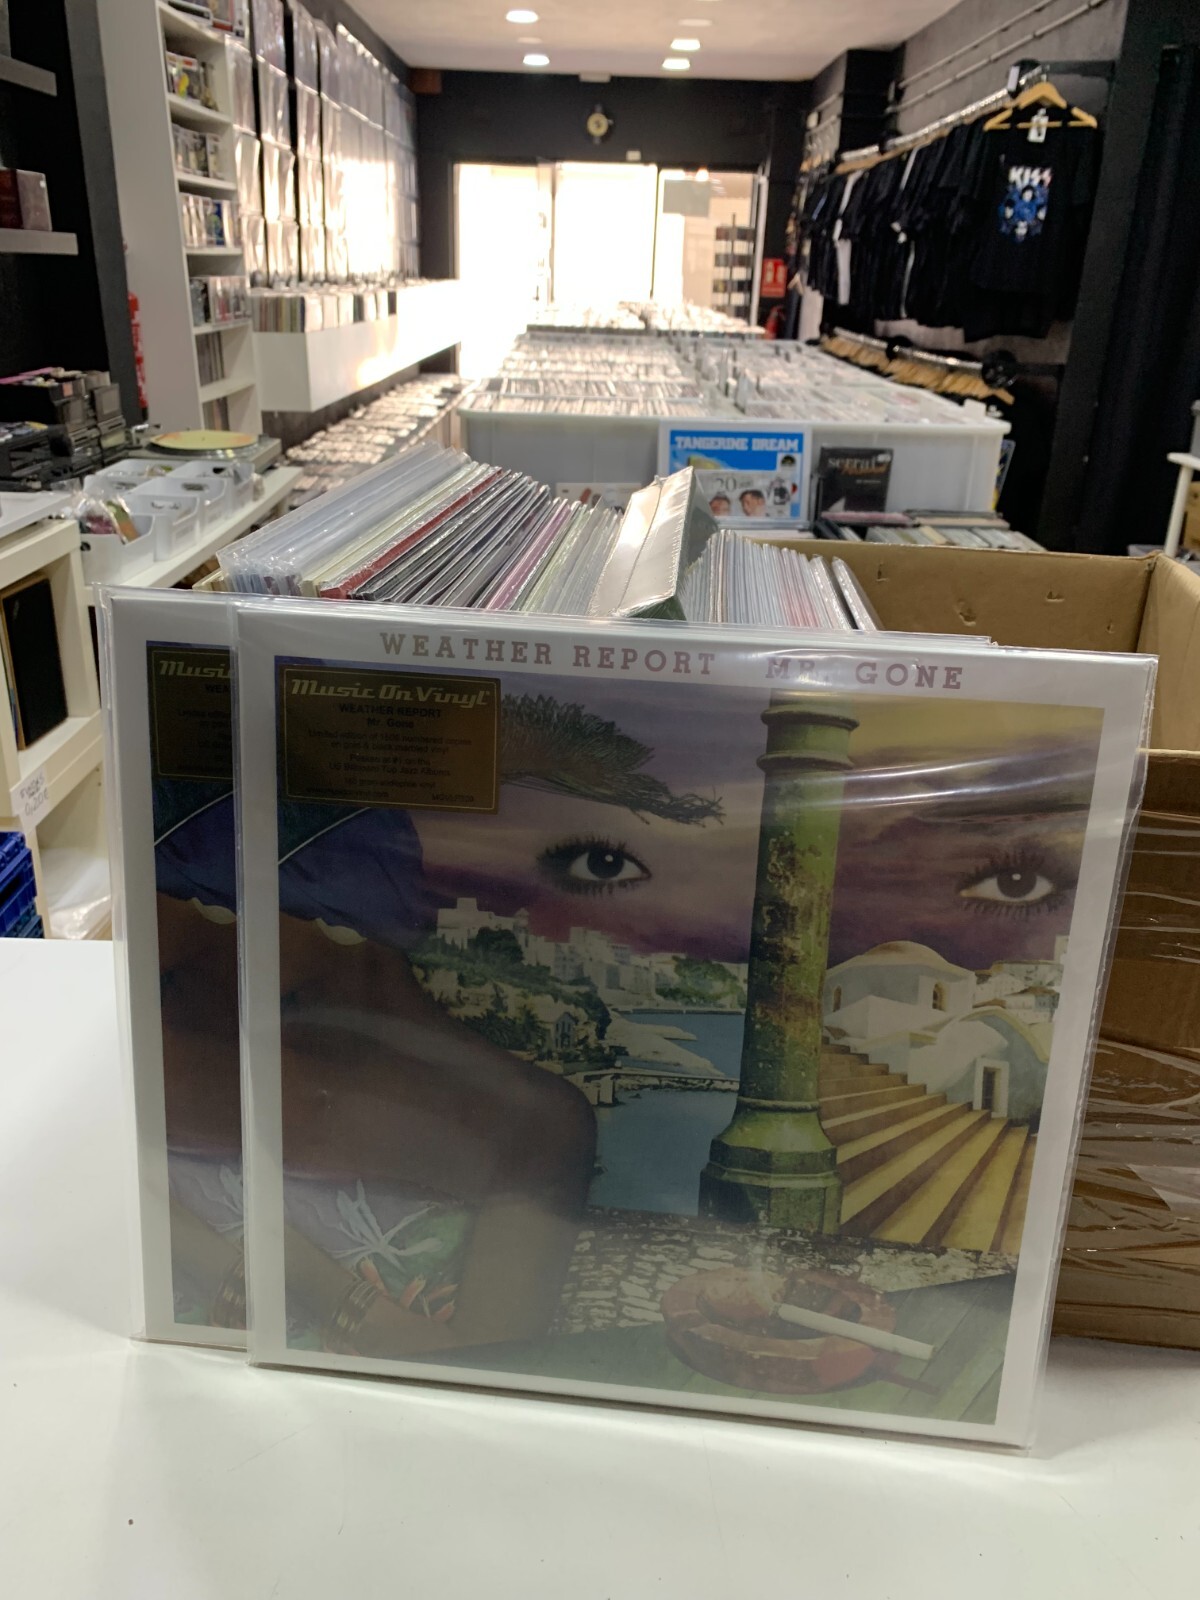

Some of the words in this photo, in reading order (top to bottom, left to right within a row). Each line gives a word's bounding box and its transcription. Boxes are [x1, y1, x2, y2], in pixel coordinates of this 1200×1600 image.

[1008, 165, 1053, 188] KISS
[674, 436, 749, 451] TANGERINE
[752, 436, 799, 452] DREAM
[379, 632, 553, 666] WEATHER
[573, 648, 716, 675] REPORT
[764, 655, 831, 681] MR.
[855, 661, 964, 690] GONE
[291, 679, 375, 699] Music
[379, 685, 414, 701] On
[416, 687, 489, 708] Vinyl
[339, 703, 394, 716] WEATHER
[397, 706, 442, 718] REPORT
[387, 719, 415, 729] Gone
